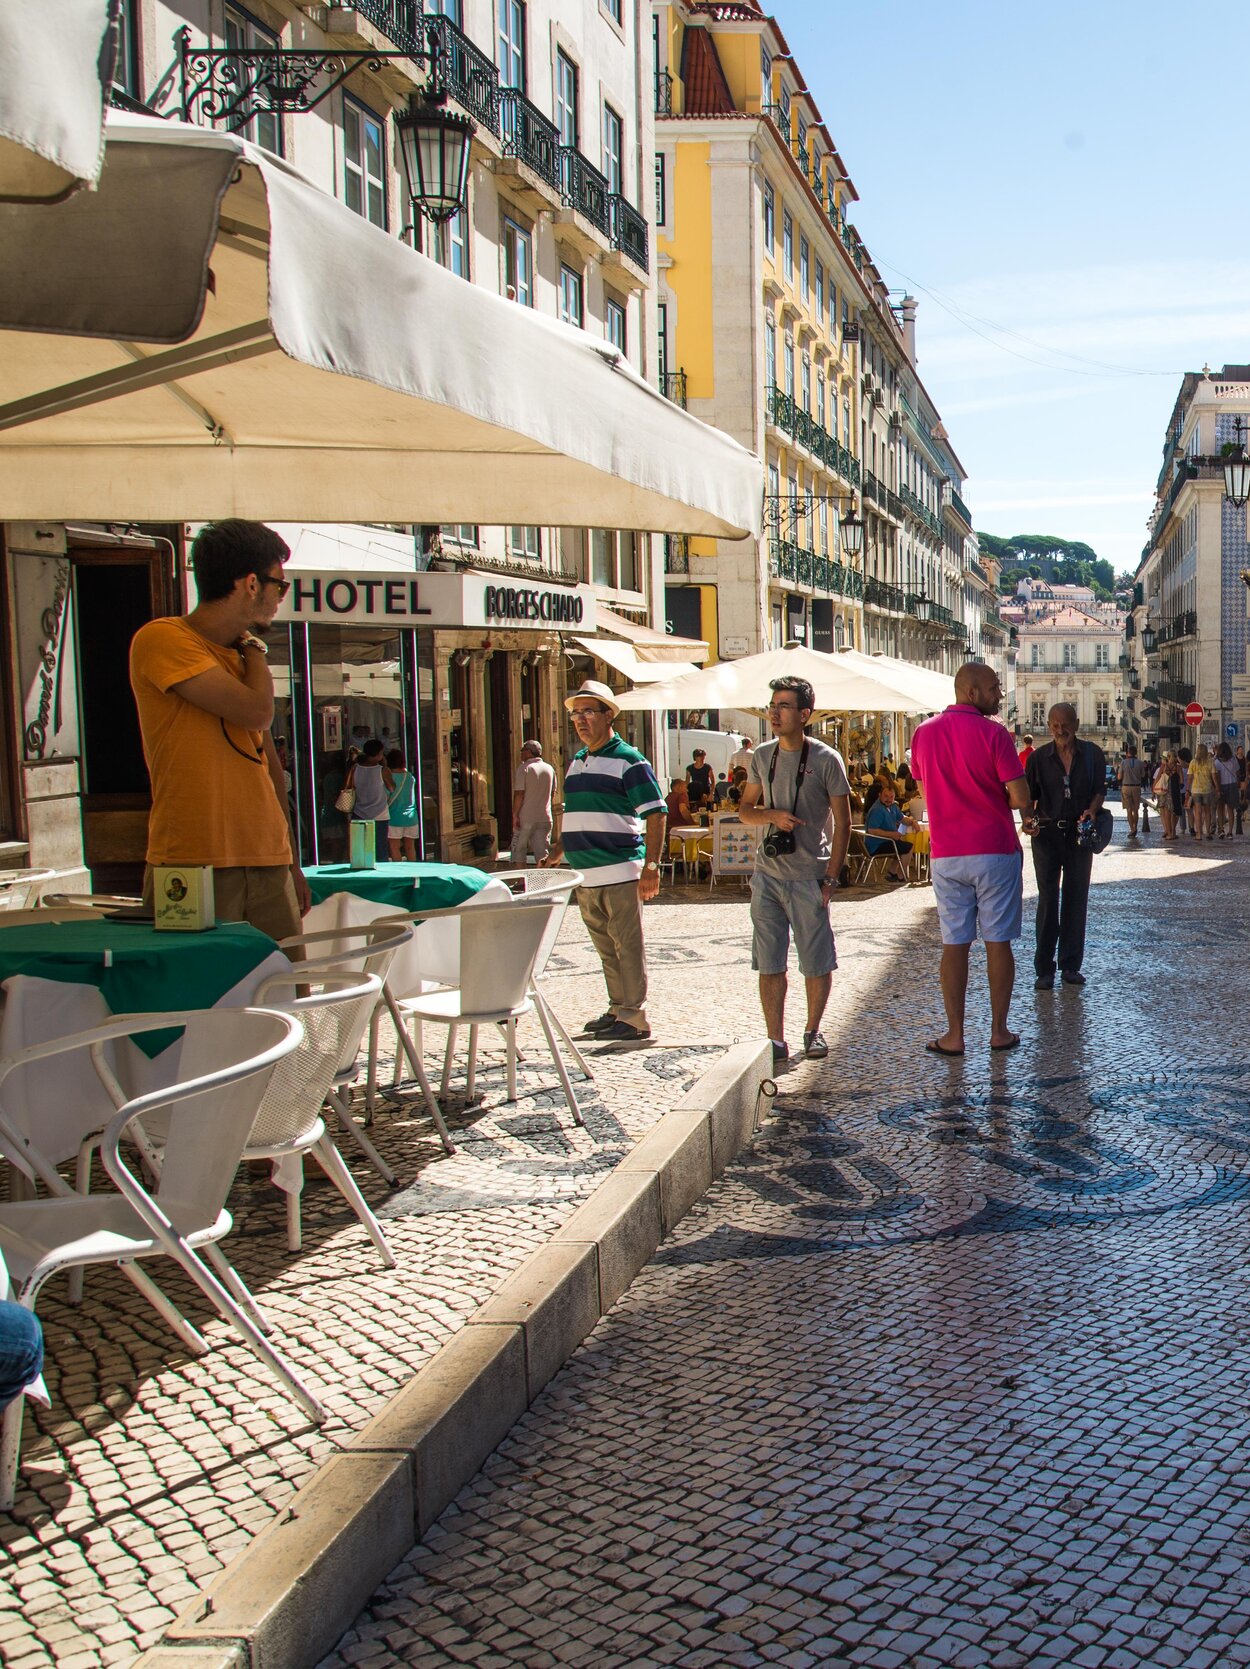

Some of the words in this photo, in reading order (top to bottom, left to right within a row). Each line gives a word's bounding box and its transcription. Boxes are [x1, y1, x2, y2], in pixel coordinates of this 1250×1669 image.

[293, 579, 432, 616] HOTEL
[486, 586, 539, 621] BORGES
[539, 591, 584, 624] CHIADO
